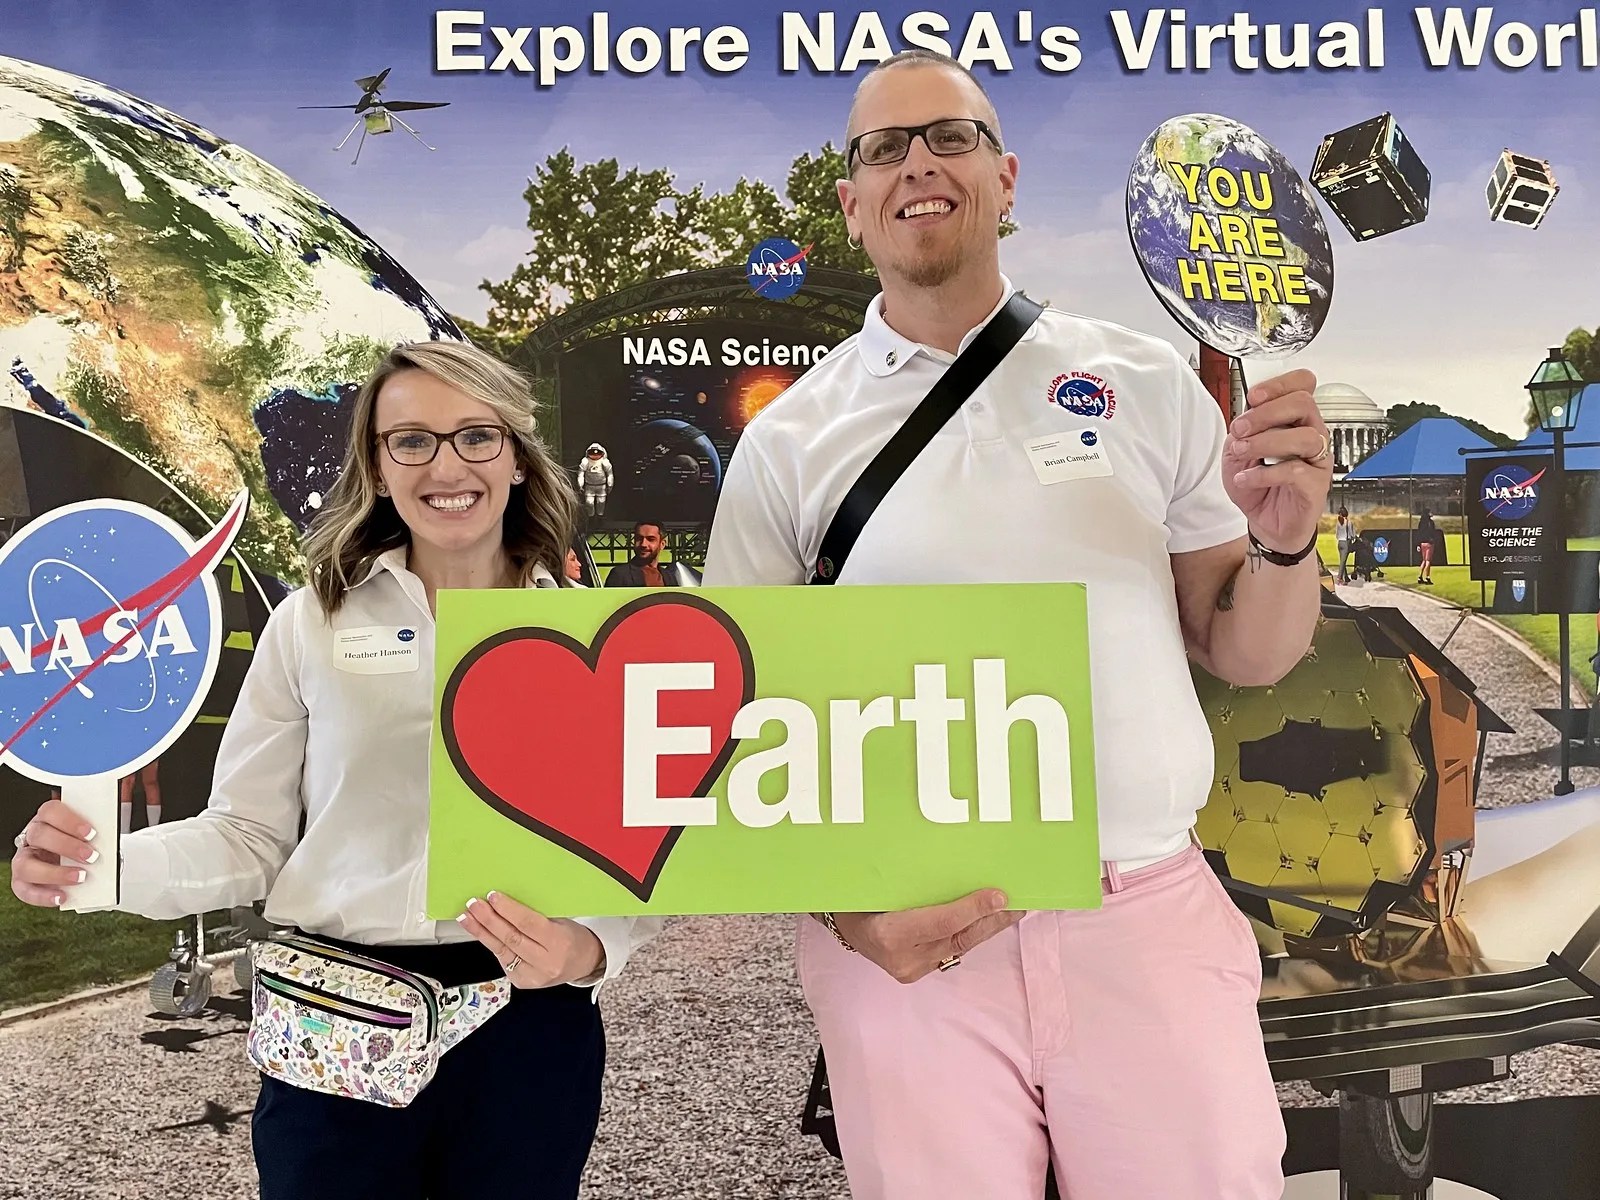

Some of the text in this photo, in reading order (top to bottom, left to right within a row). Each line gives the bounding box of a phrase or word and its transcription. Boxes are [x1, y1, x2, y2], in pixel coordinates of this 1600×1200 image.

[436, 10, 749, 86] Explore
[782, 10, 1082, 72] NASA's
[1109, 8, 1385, 70] Virtual
[1169, 162, 1274, 211] YOU
[1189, 212, 1284, 257] ARE
[751, 262, 803, 276] NASA
[1177, 259, 1311, 304] HERE
[623, 337, 712, 366] NASA
[1060, 396, 1104, 407] NASA
[1071, 371, 1104, 384] FLIGHT
[1103, 389, 1117, 421] FACILITY
[1044, 452, 1100, 467] Brian Campbell
[1485, 485, 1536, 499] NASA
[1481, 527, 1543, 537] SHARE THE
[1488, 537, 1537, 547] SCIENCE
[0, 604, 198, 677] NASA
[344, 649, 412, 659] Heather Hanson
[622, 658, 1074, 829] Earth
